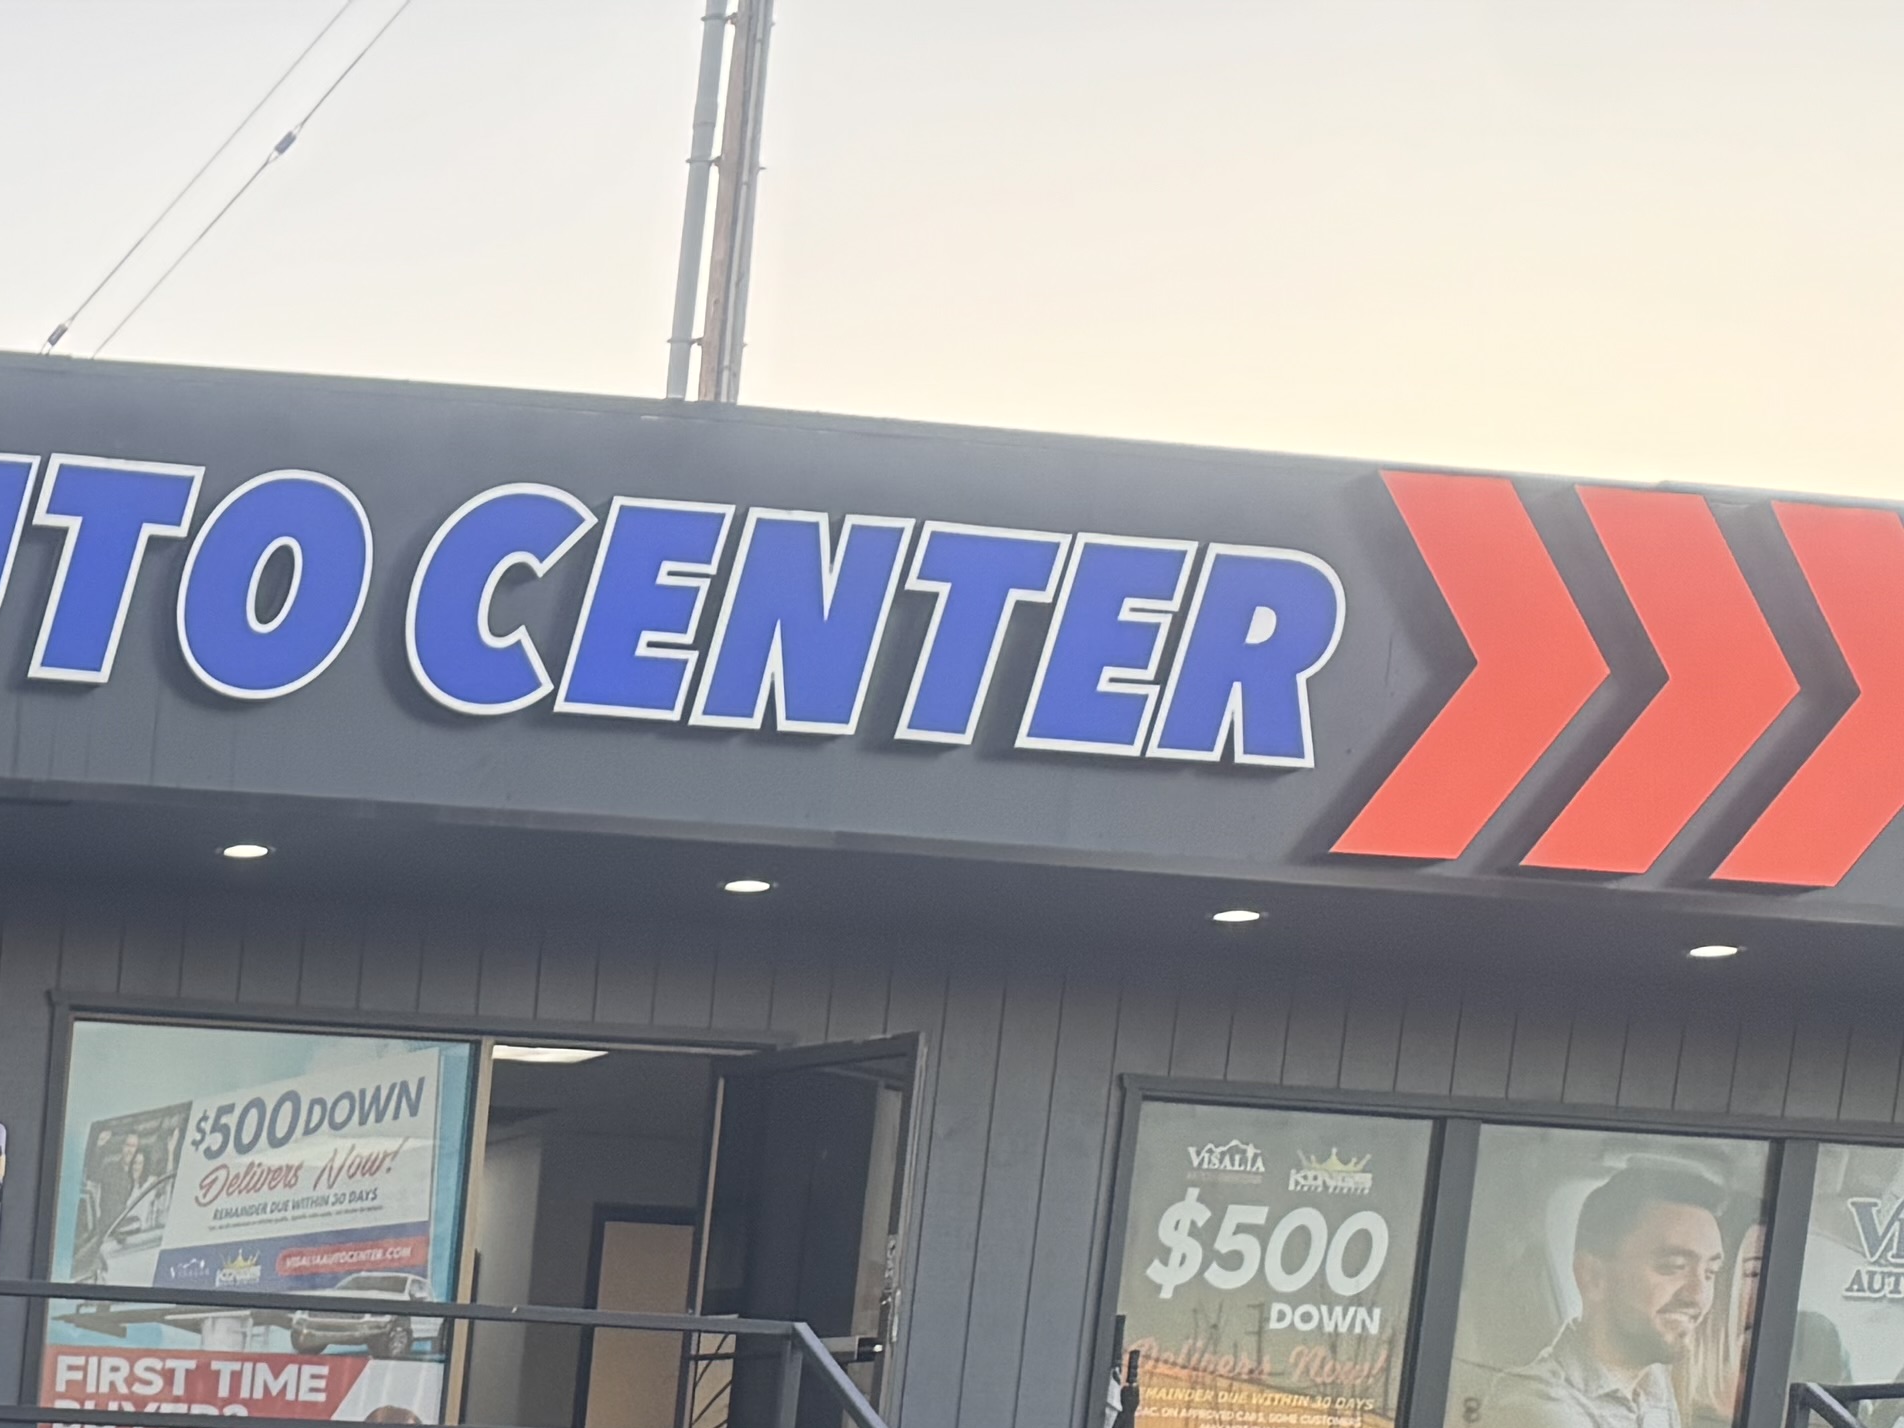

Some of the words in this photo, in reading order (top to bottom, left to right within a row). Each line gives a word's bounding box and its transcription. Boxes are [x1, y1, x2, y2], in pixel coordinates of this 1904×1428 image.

[404, 481, 1348, 769] CENTER
[191, 1089, 303, 1161] $500
[302, 1076, 426, 1137] DOWN
[195, 1160, 304, 1207] Delivers
[312, 1136, 409, 1192] Now!
[1187, 1140, 1265, 1173] VISALIA
[1145, 1187, 1389, 1299] $500
[1268, 1302, 1381, 1335] DOWN
[54, 1355, 198, 1396] FIRST
[210, 1360, 330, 1401] TIME
[1334, 1397, 1375, 1411] DAYS
